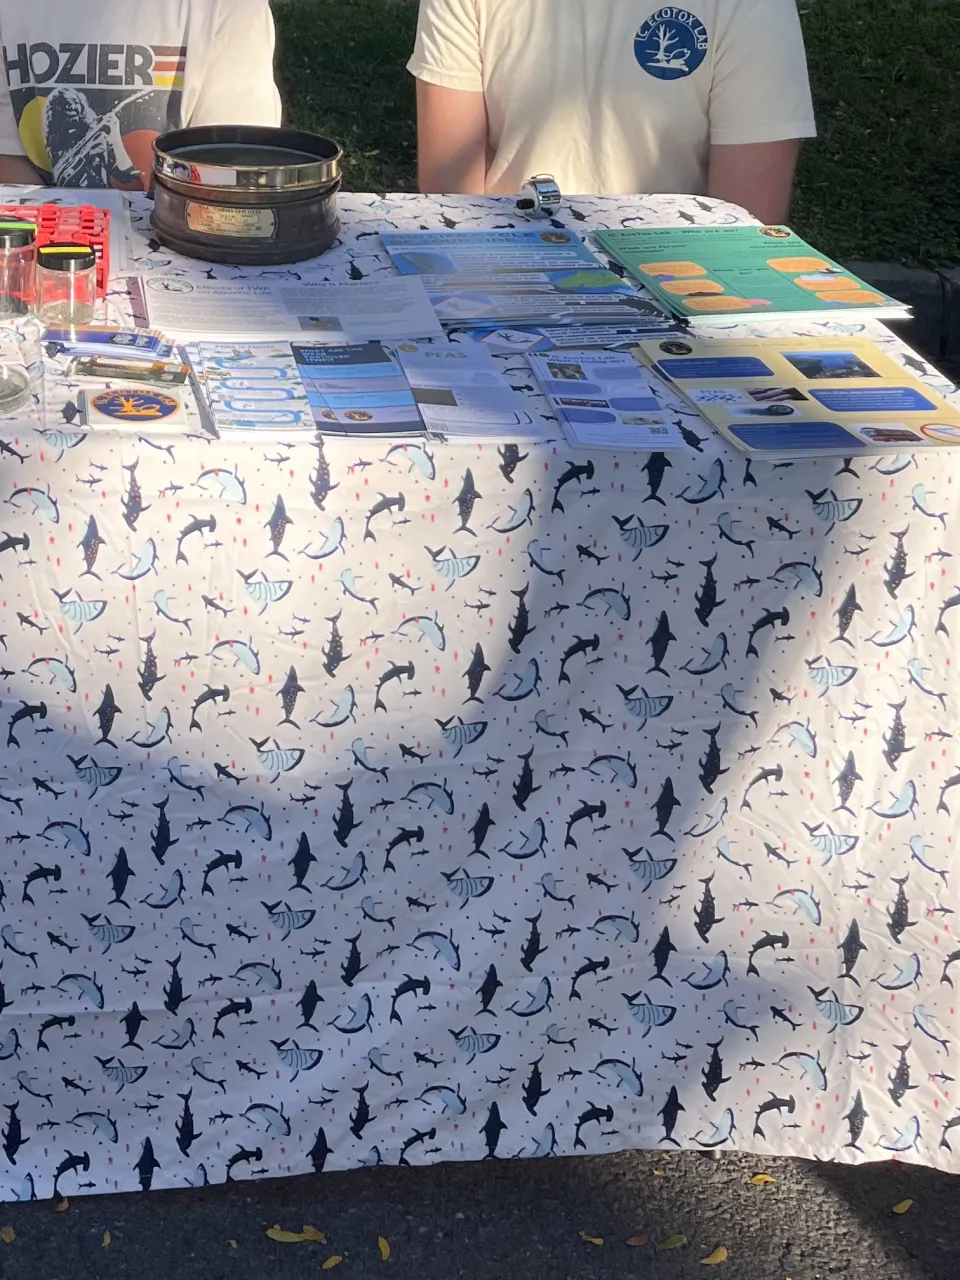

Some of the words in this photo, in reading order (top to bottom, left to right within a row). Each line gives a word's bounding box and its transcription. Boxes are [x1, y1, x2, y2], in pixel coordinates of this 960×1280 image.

[634, 28, 648, 41] IC
[646, 7, 697, 26] ECOTOX
[693, 25, 709, 50] LAB
[2, 42, 154, 87] HOZIER
[424, 351, 468, 359] PFAS
